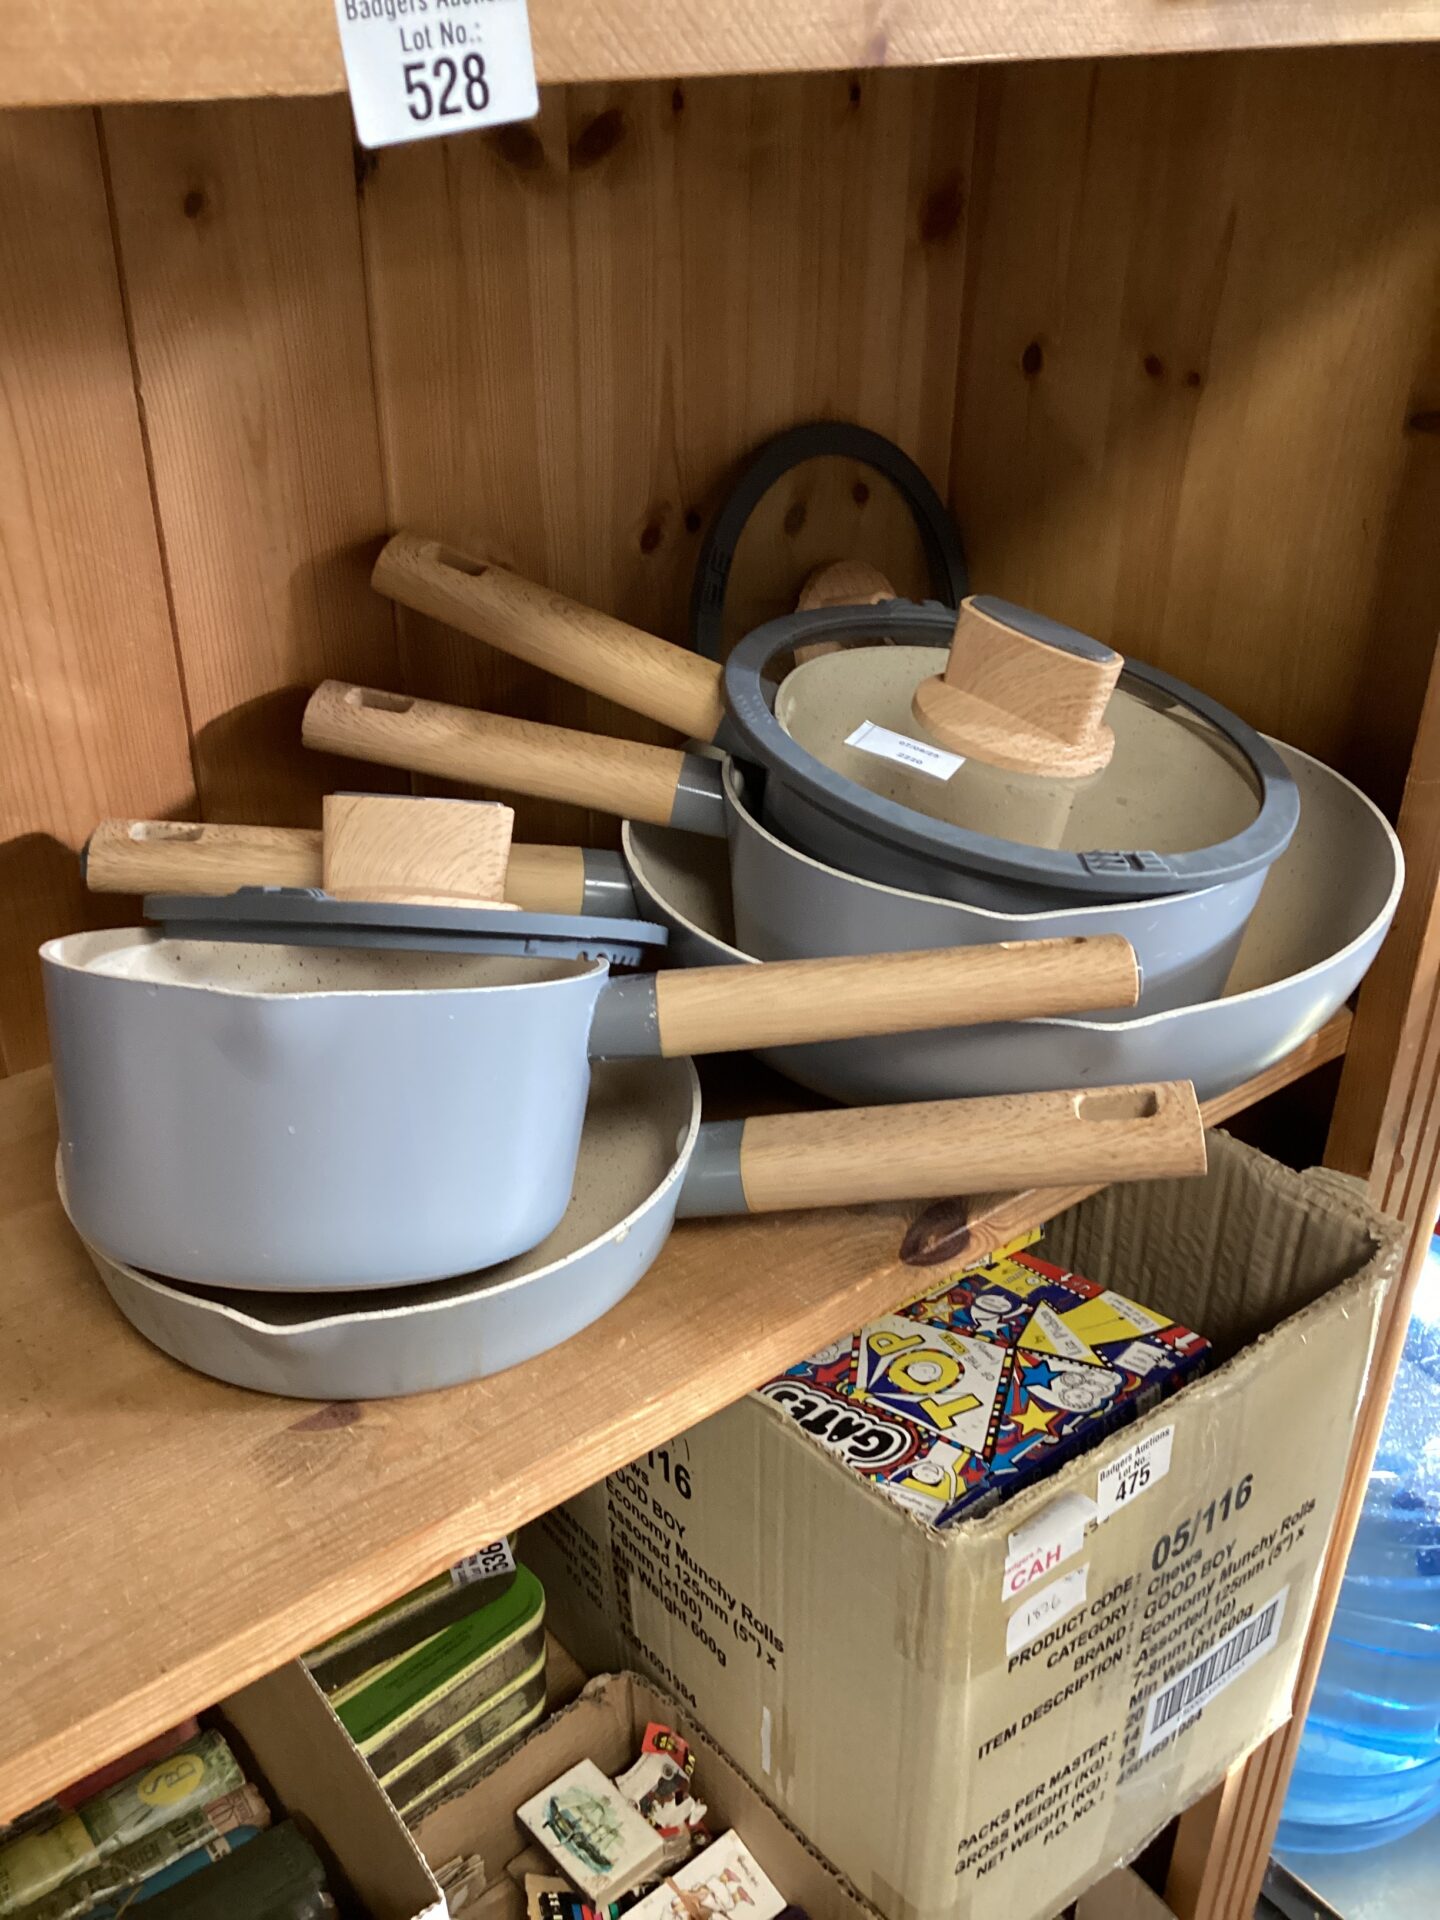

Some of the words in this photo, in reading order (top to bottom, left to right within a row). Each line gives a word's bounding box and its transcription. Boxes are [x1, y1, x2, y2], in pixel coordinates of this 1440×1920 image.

[400, 27, 432, 51] Lot
[403, 52, 490, 120] 528
[867, 1331, 983, 1430] TOP
[1100, 1452, 1133, 1482] Badgers
[1135, 1428, 1170, 1455] Auctions
[1115, 1463, 1151, 1502] 475
[1118, 1463, 1131, 1481] Lot
[615, 1468, 648, 1504] OOD
[653, 1498, 686, 1538] BOY
[1152, 1473, 1254, 1571] 05/116
[480, 1542, 509, 1574] 536
[606, 1476, 671, 1550] Economy
[675, 1542, 737, 1611] Munchy
[741, 1602, 785, 1653] Rolls
[608, 1499, 670, 1569] Assorted
[675, 1564, 729, 1625] 125mm
[659, 1568, 703, 1622] (x100)
[1010, 1544, 1061, 1591] CAH
[1140, 1577, 1216, 1643] Economy
[1219, 1528, 1278, 1585] Munchy
[1280, 1498, 1317, 1536] Rolls
[1144, 1571, 1196, 1619] GOOD
[1201, 1538, 1237, 1579] BOY
[638, 1566, 688, 1627] Weight
[691, 1620, 727, 1667] 600g
[1008, 1609, 1089, 1674] PRODUCT
[1147, 1548, 1203, 1596] Chews
[1135, 1599, 1209, 1668] Assorted
[1215, 1559, 1265, 1609] 125mm
[978, 1722, 1018, 1760] ITEM
[1134, 1640, 1187, 1688] 7-8mm
[1191, 1598, 1236, 1647] (x100)
[1129, 1680, 1158, 1709] Min
[1219, 1603, 1254, 1639] 600g
[954, 1828, 1009, 1875] GROSS
[1013, 1781, 1073, 1833] WEIGHT
[1123, 1726, 1141, 1748] 14
[957, 1808, 1011, 1855] PACKS
[1014, 1782, 1046, 1815] PER
[976, 1848, 1008, 1880] NET
[1011, 1801, 1069, 1853] WEIGHT
